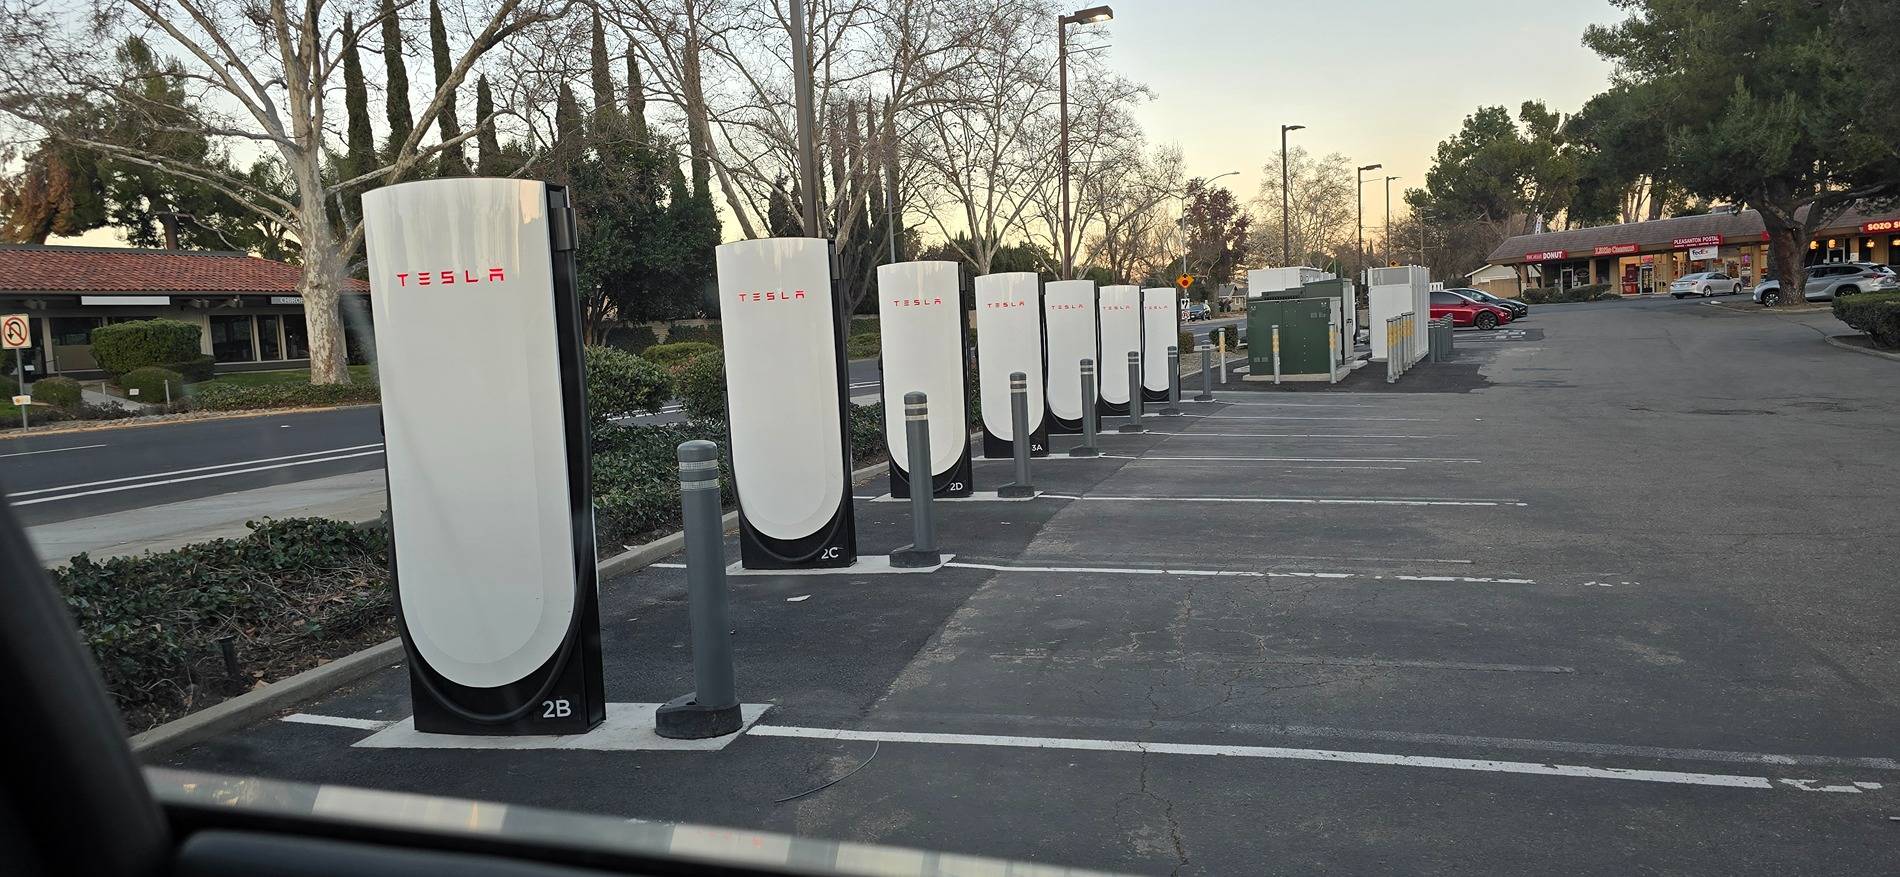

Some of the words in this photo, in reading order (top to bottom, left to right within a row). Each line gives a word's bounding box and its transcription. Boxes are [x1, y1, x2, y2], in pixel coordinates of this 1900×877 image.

[1867, 221, 1892, 231] SOZO
[1893, 221, 1900, 229] S
[1542, 251, 1563, 260] DONUT
[397, 267, 506, 287] TESLA
[738, 290, 805, 302] TESLA
[894, 298, 942, 307] TESLA
[986, 300, 1025, 308] TESLA
[1031, 444, 1043, 452] 3A
[949, 481, 964, 492] 2D
[820, 547, 840, 560] 2C
[541, 699, 572, 719] 2B
